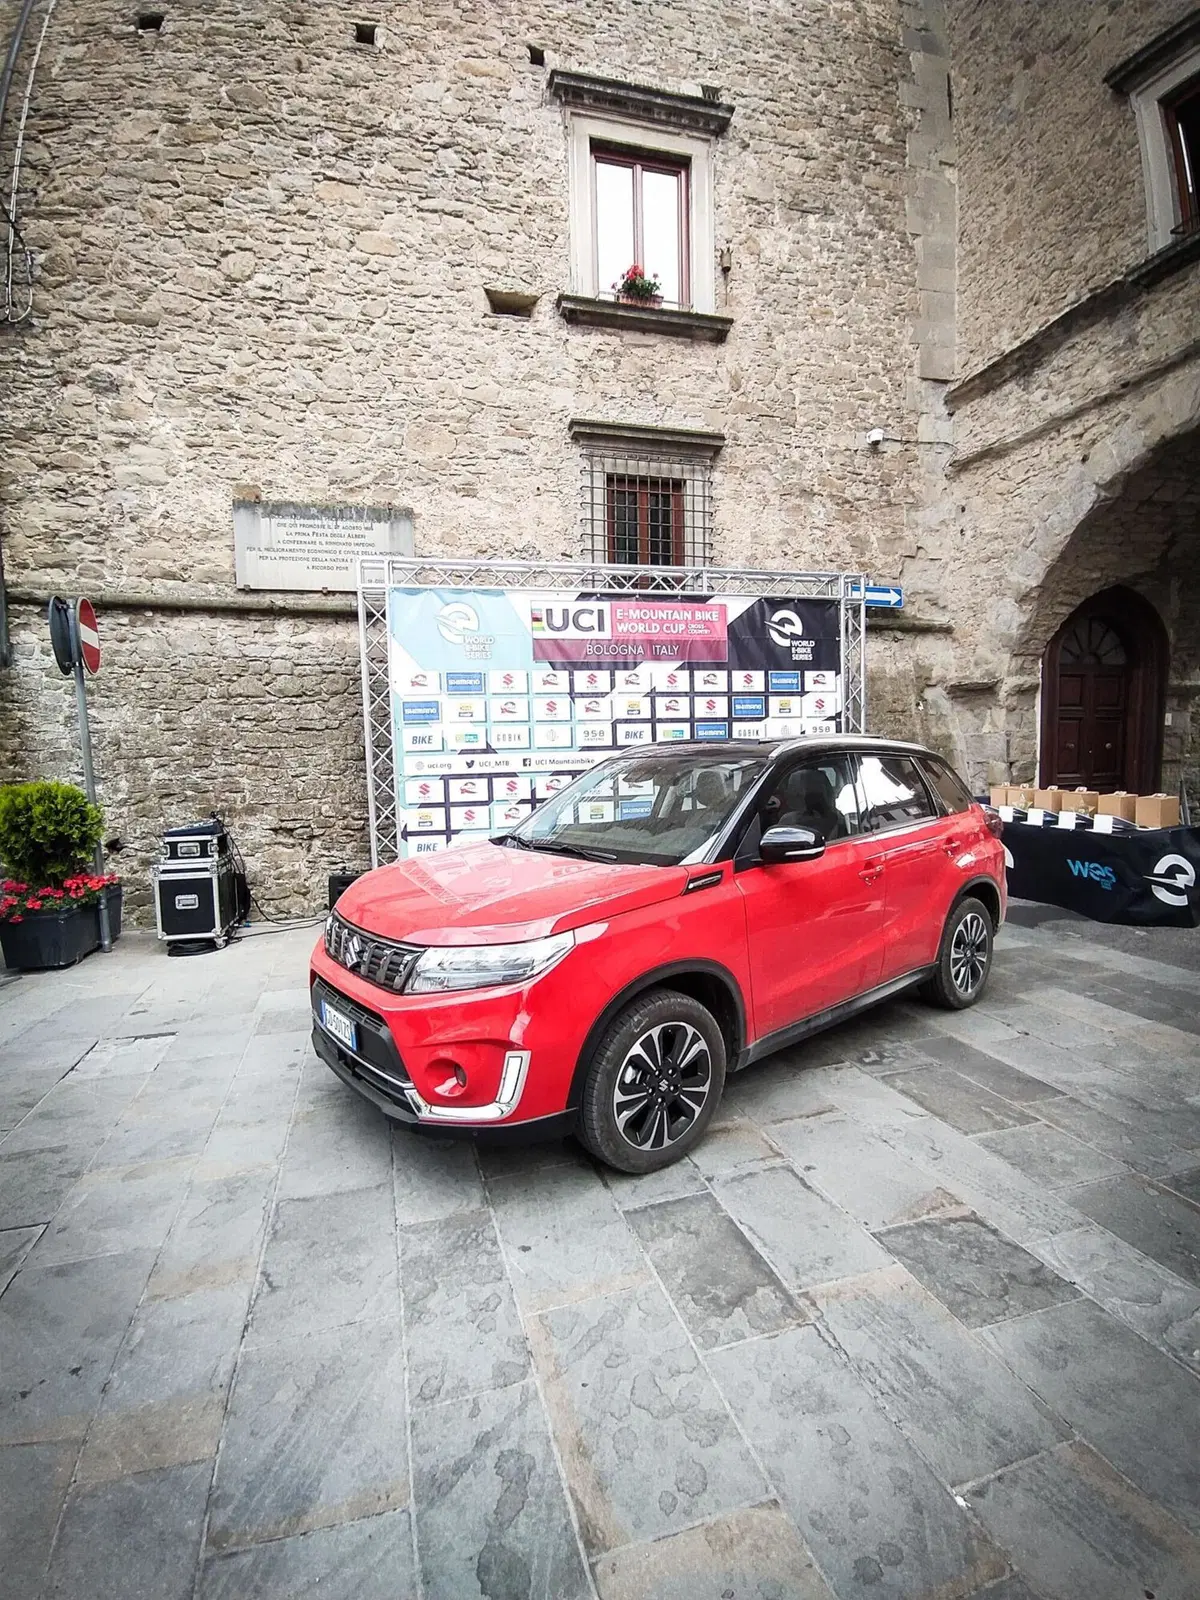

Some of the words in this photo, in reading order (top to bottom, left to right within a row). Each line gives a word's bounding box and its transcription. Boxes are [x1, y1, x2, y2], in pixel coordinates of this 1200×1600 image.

[546, 608, 605, 632] UCI
[616, 608, 692, 620] E-MOUNTAIN
[694, 610, 719, 622] BIKE
[617, 622, 660, 634] WORLD
[663, 623, 686, 634] CUP
[465, 636, 494, 644] WORLD
[586, 644, 644, 656] BOLOGNA
[652, 644, 679, 656] ITALY
[466, 652, 492, 660] SERIES
[583, 730, 605, 738] 958
[624, 730, 644, 740] BIKE
[412, 736, 433, 744] BIKE
[548, 758, 596, 766] Mountainbike
[417, 842, 438, 852] BIKE
